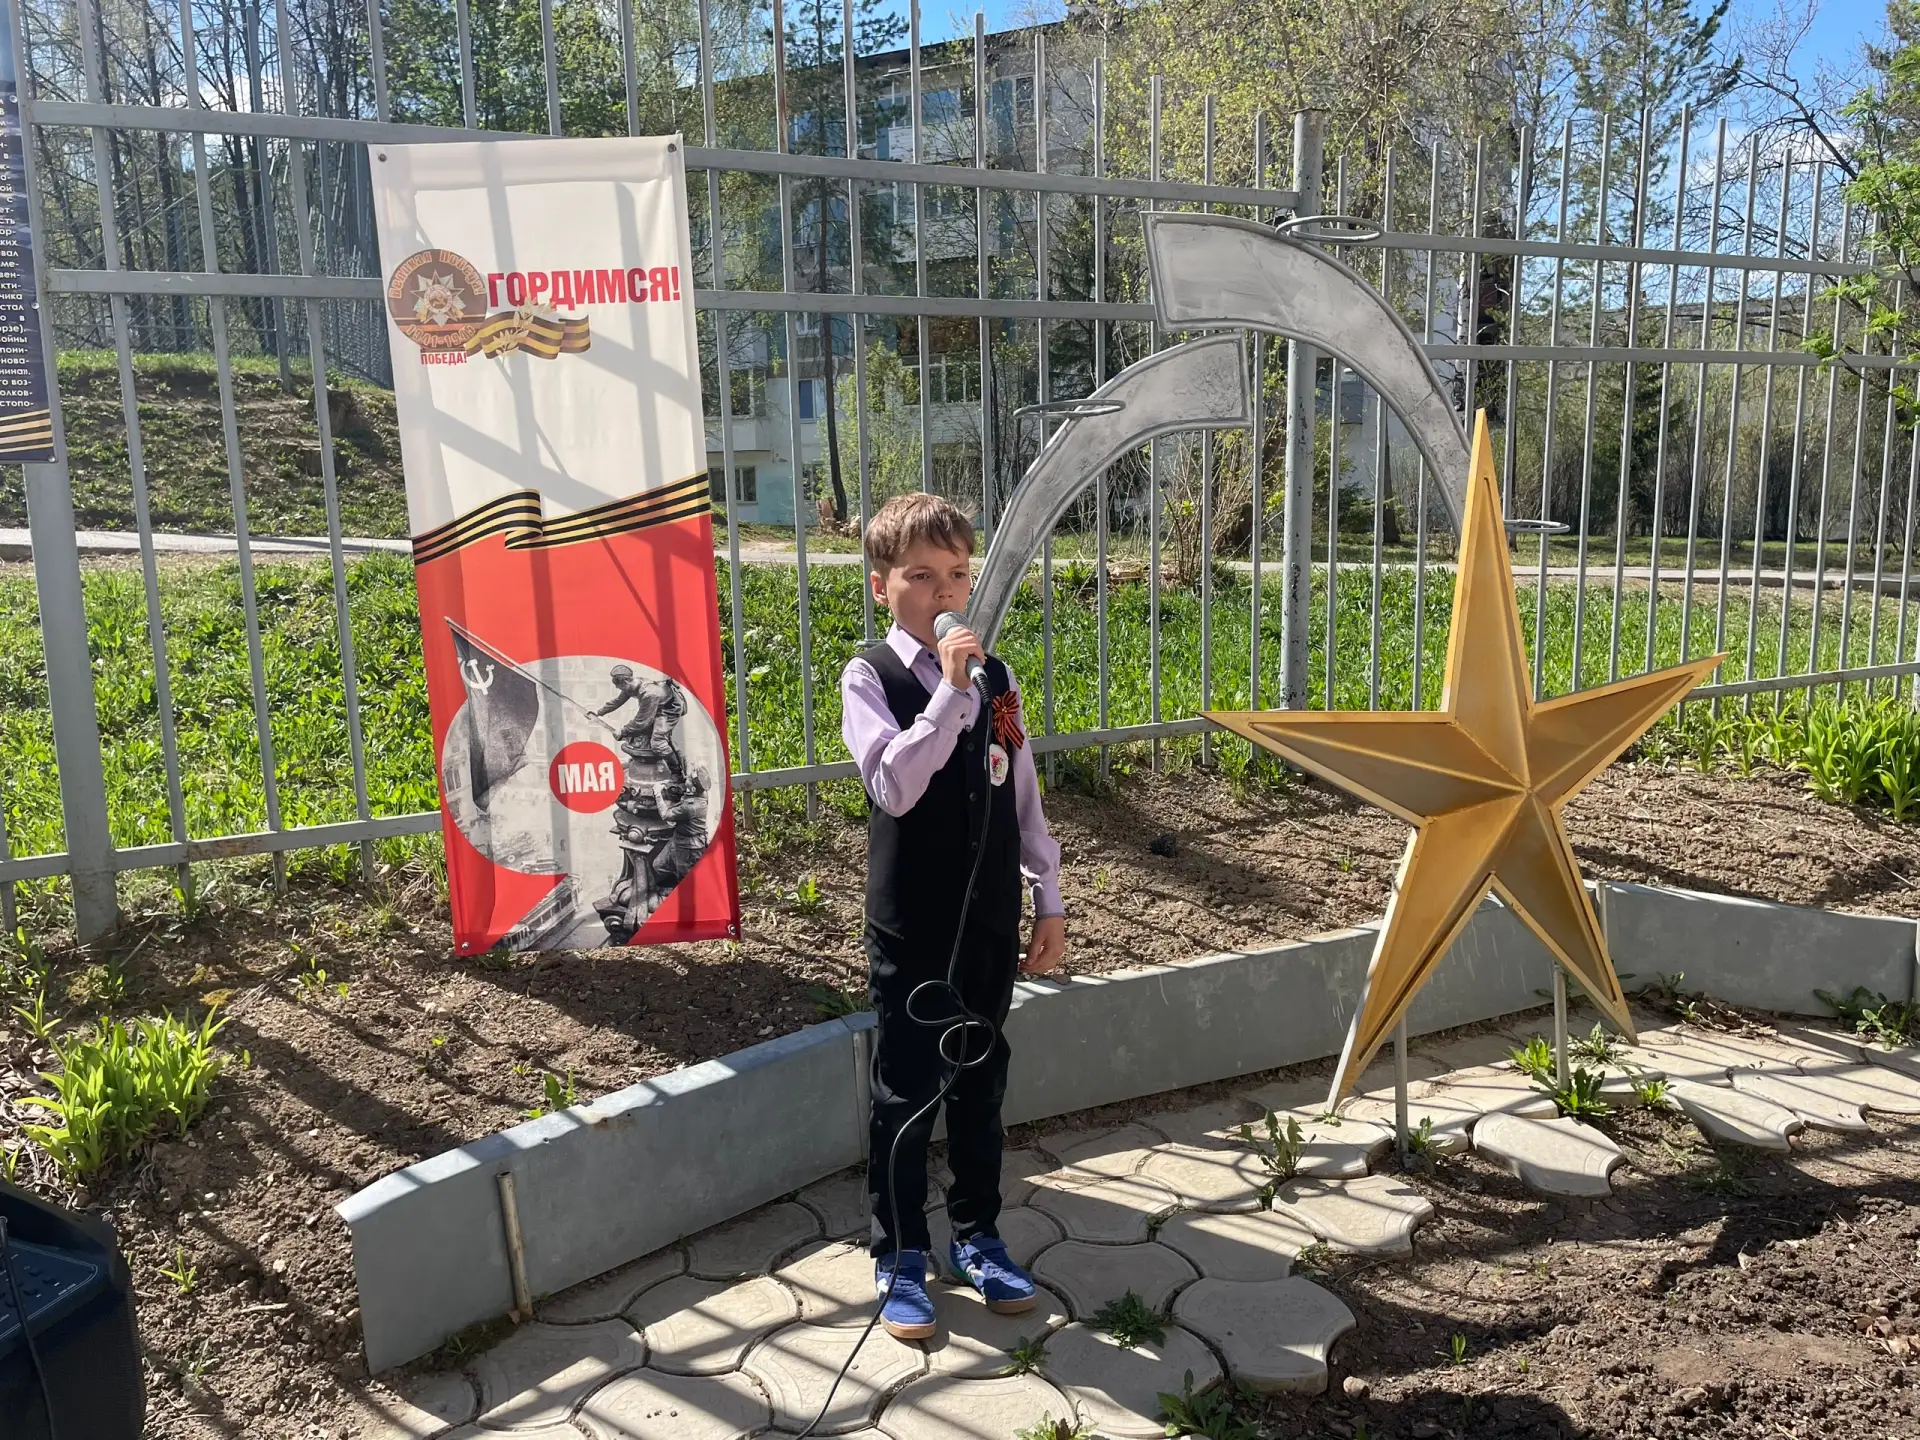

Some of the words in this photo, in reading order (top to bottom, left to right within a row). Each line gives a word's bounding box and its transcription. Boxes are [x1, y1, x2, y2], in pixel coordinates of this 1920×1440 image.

[0, 183, 13, 192] ой
[487, 266, 681, 311] ГОРДИМСЯ!
[0, 324, 26, 334] рзе).
[406, 324, 476, 348] 1941-1945
[0, 334, 28, 343] ойны
[420, 352, 468, 366] ПОБЕДА!
[557, 761, 616, 794] МАЯ
